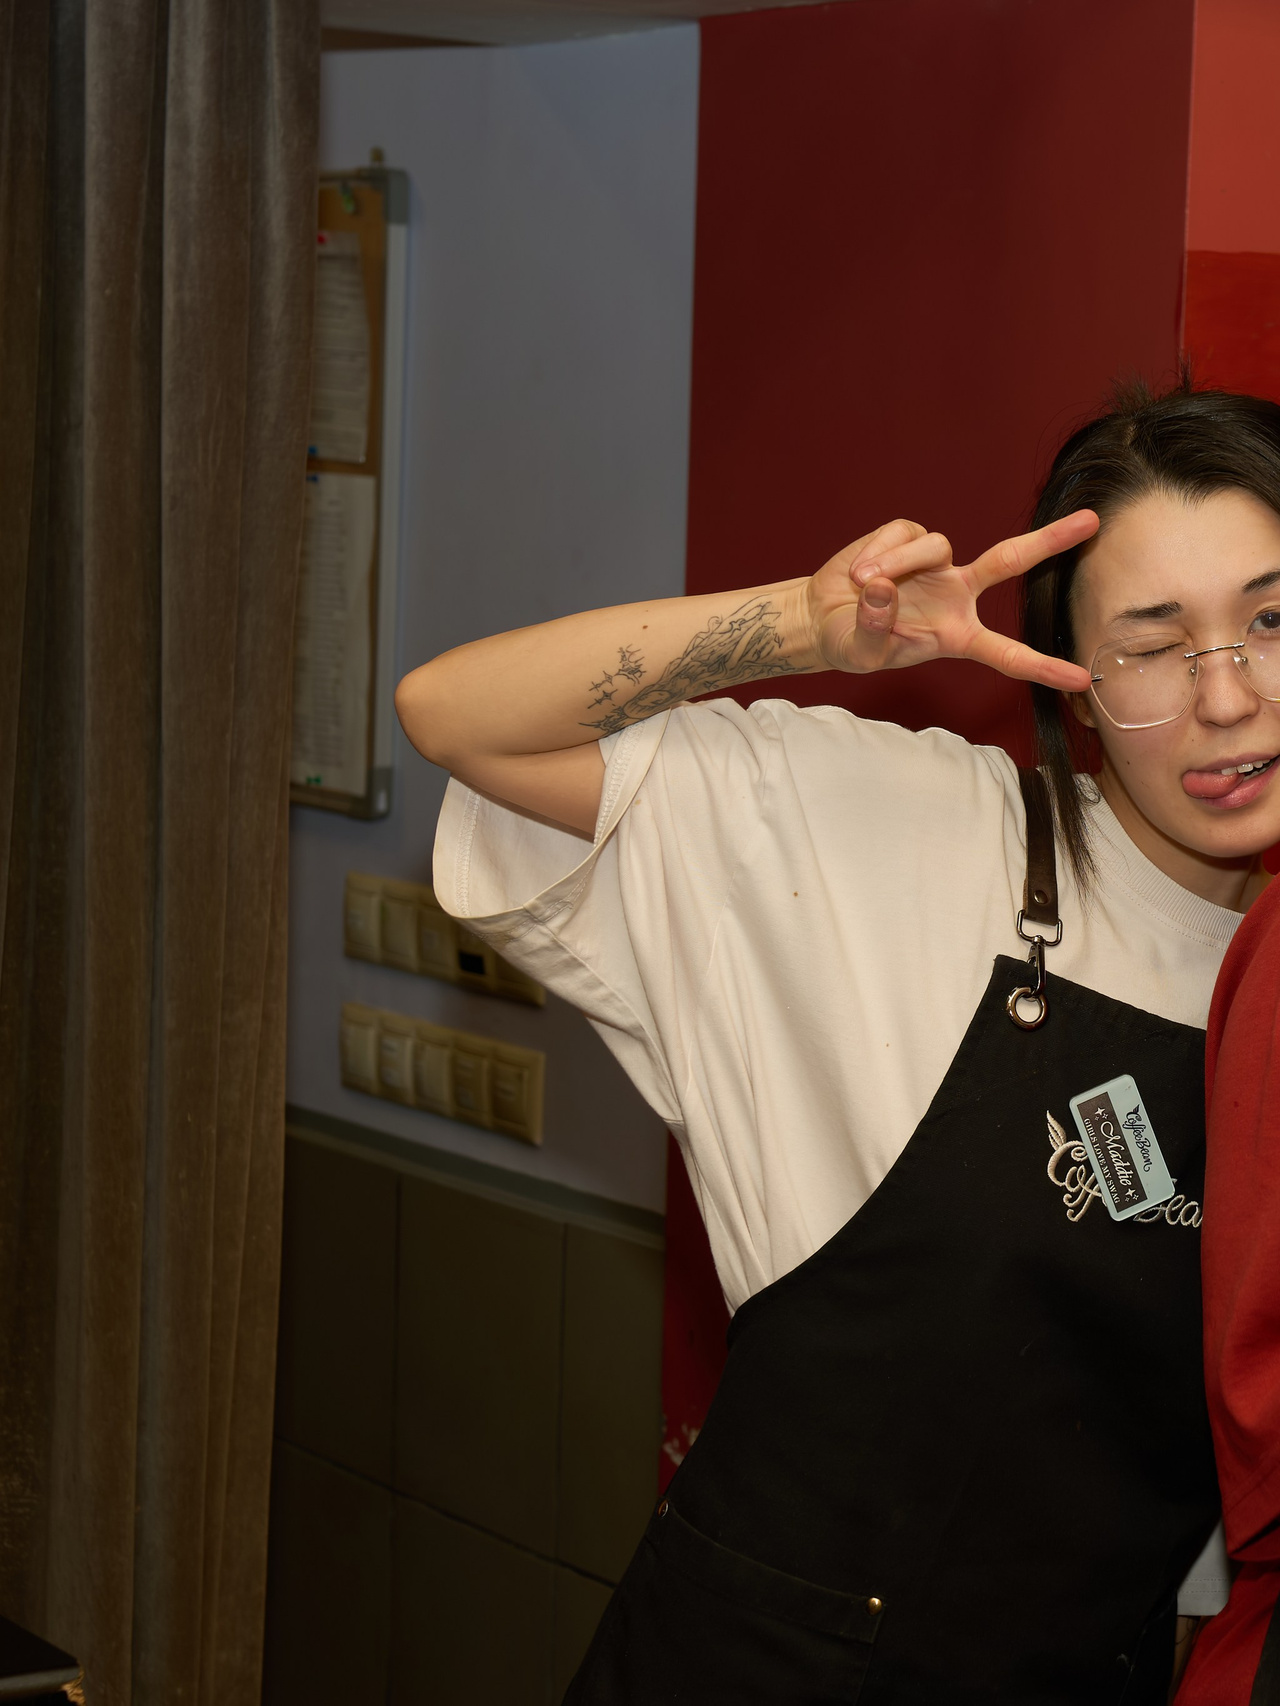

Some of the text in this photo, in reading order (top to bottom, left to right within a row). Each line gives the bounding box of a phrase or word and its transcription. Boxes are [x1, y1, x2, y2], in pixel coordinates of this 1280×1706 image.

[1083, 1117, 1121, 1204] GIRLS LOVE MY SWAG
[1100, 1120, 1133, 1186] Maddie
